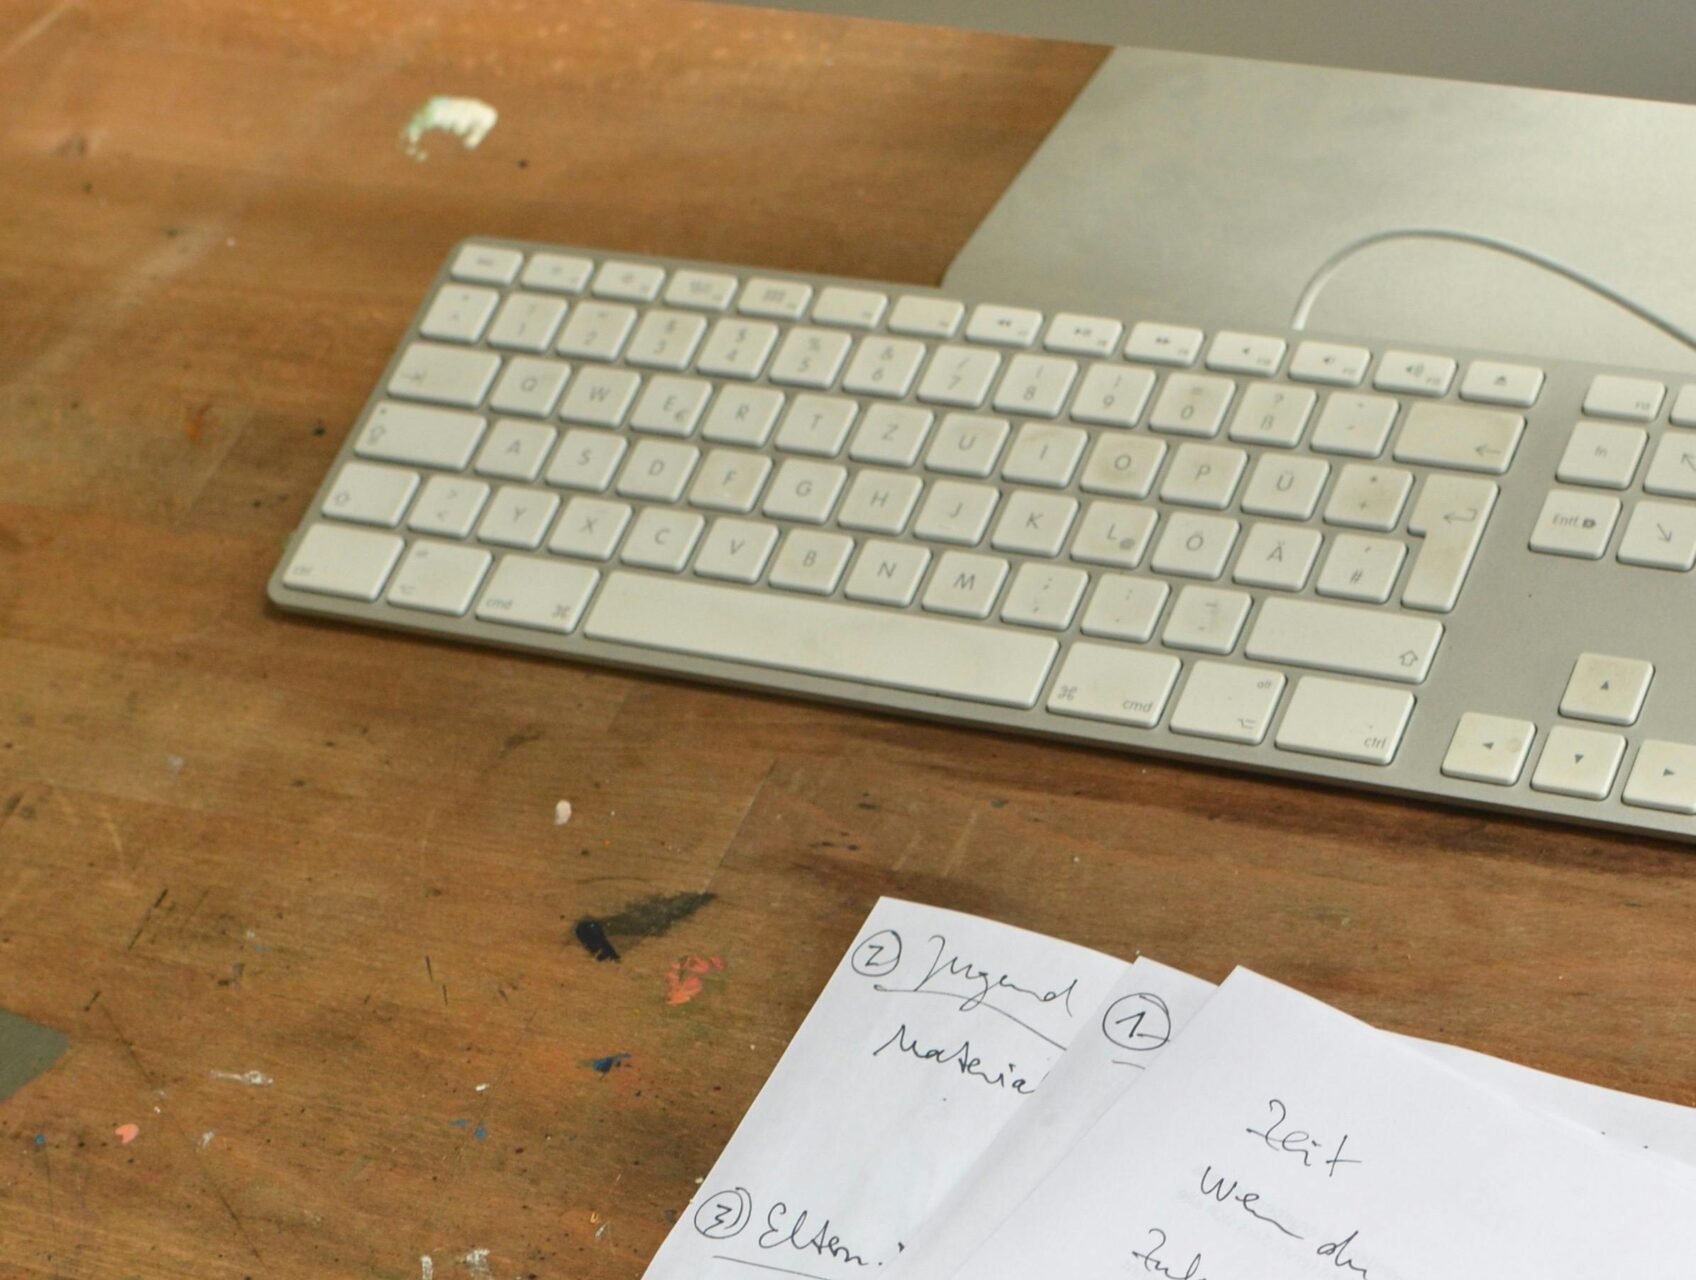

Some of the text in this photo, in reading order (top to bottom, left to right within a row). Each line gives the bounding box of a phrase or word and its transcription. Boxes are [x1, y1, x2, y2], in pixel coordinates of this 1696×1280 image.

[520, 376, 538, 392] Q
[589, 387, 610, 402] W
[663, 395, 676, 411] E
[736, 405, 749, 419] R
[811, 414, 823, 429] T
[882, 424, 899, 440] Z
[506, 440, 521, 454] A
[958, 434, 976, 450] U
[578, 449, 591, 465] S
[1040, 444, 1048, 460] I
[648, 459, 665, 476] D
[1114, 454, 1132, 471] O
[723, 470, 736, 485] F
[1195, 464, 1211, 480] P
[795, 480, 812, 497] G
[1276, 470, 1294, 491] Ü
[870, 491, 889, 507] H
[514, 507, 526, 521] Y
[949, 503, 963, 518] J
[582, 518, 597, 533] X
[1026, 513, 1042, 528] K
[654, 528, 670, 544] C
[1107, 524, 1116, 541] L
[730, 540, 744, 555] V
[1186, 532, 1204, 551] Ö
[803, 550, 817, 567] B
[1267, 542, 1282, 562] Ä
[878, 562, 896, 578] N
[954, 573, 975, 590] M
[1257, 680, 1272, 689] alt
[1122, 700, 1153, 712] cmd
[1364, 737, 1386, 749] ctrl
[914, 935, 1078, 1017] Jugend
[873, 1024, 1048, 1095] Materia
[1246, 1099, 1362, 1177] Zeit
